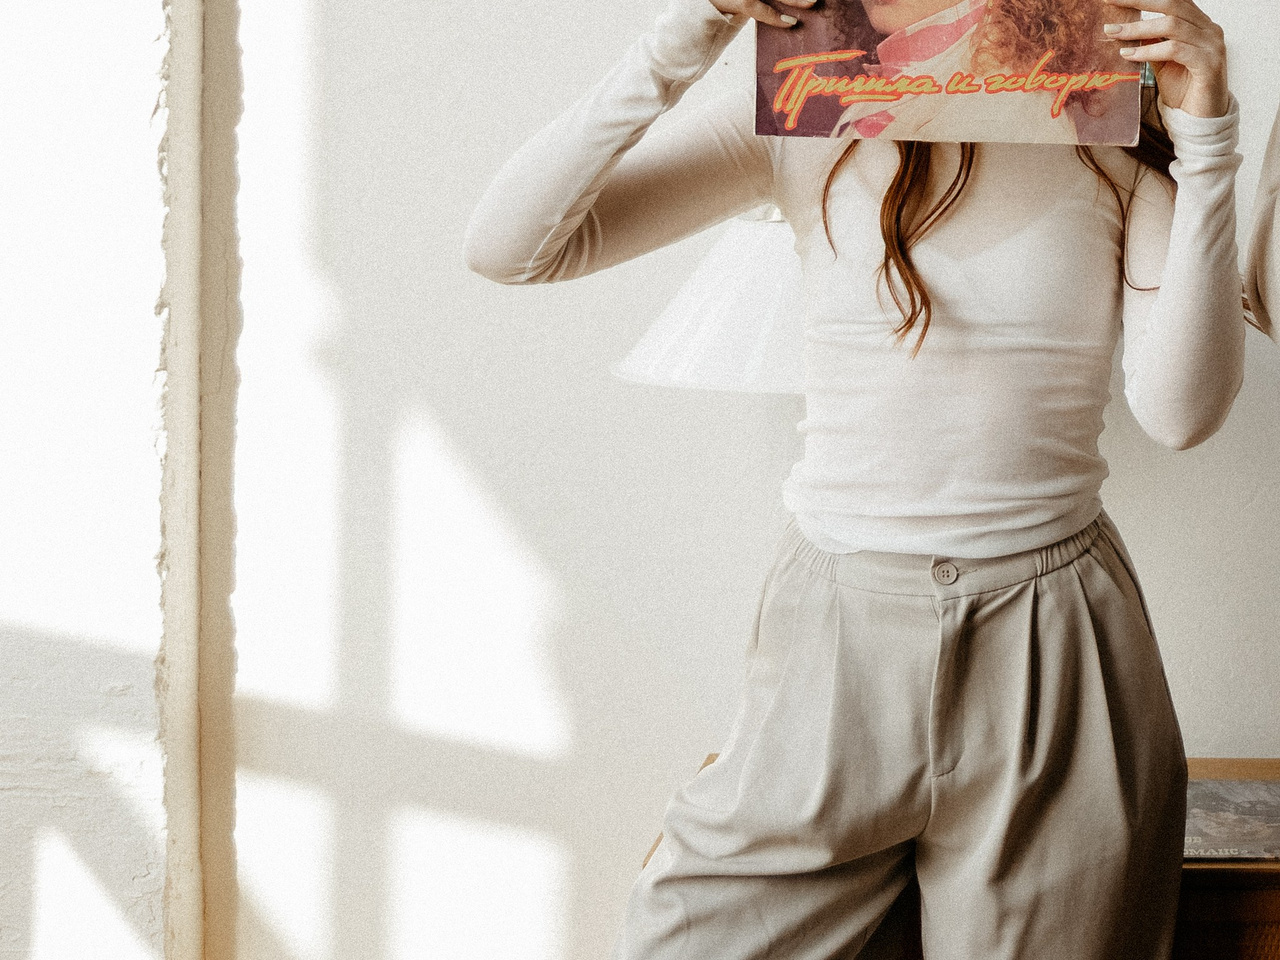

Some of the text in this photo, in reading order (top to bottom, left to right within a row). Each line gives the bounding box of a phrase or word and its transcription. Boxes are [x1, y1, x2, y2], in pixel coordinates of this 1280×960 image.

[773, 49, 1140, 130] Пришла и говорю
